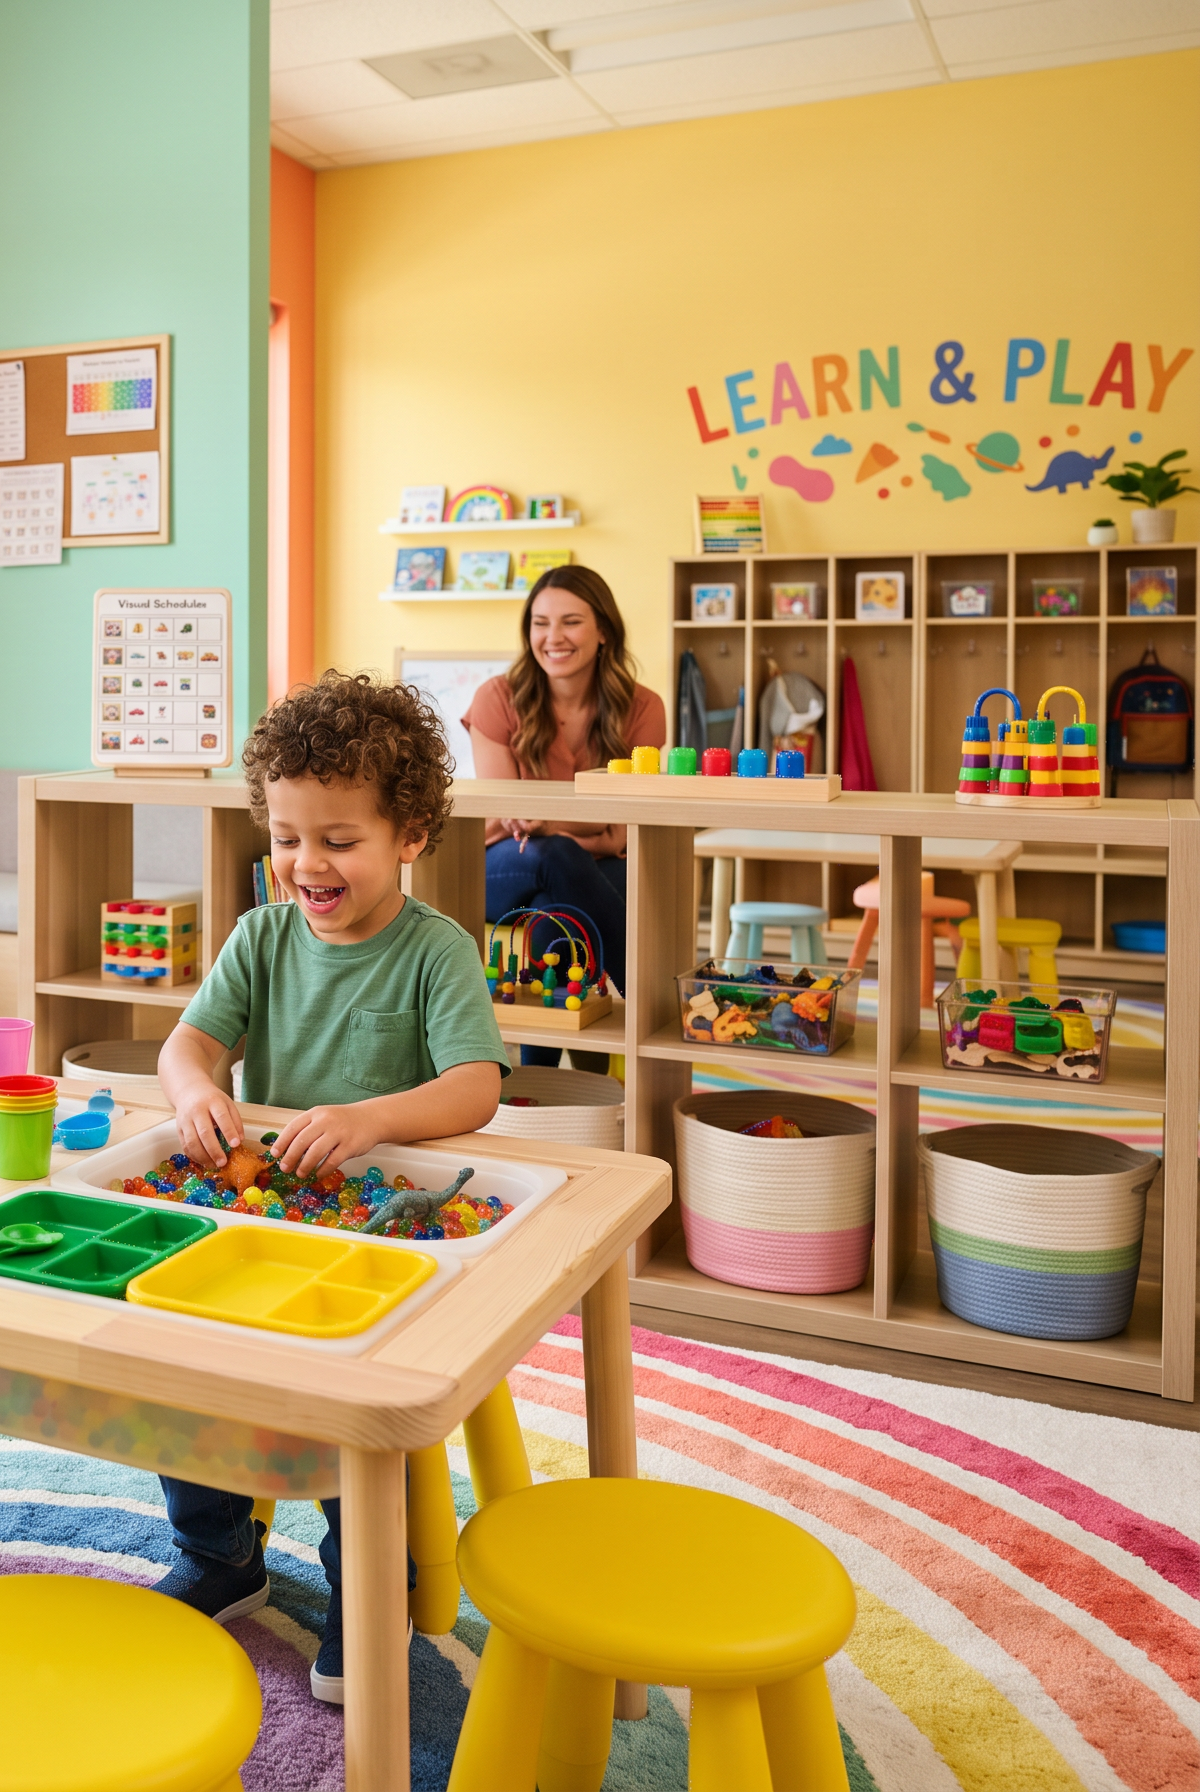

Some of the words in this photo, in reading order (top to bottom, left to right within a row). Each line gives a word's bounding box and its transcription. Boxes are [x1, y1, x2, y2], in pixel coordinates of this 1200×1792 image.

[687, 345, 902, 444] LEARN
[929, 340, 977, 405] &
[1004, 338, 1195, 413] PLAY
